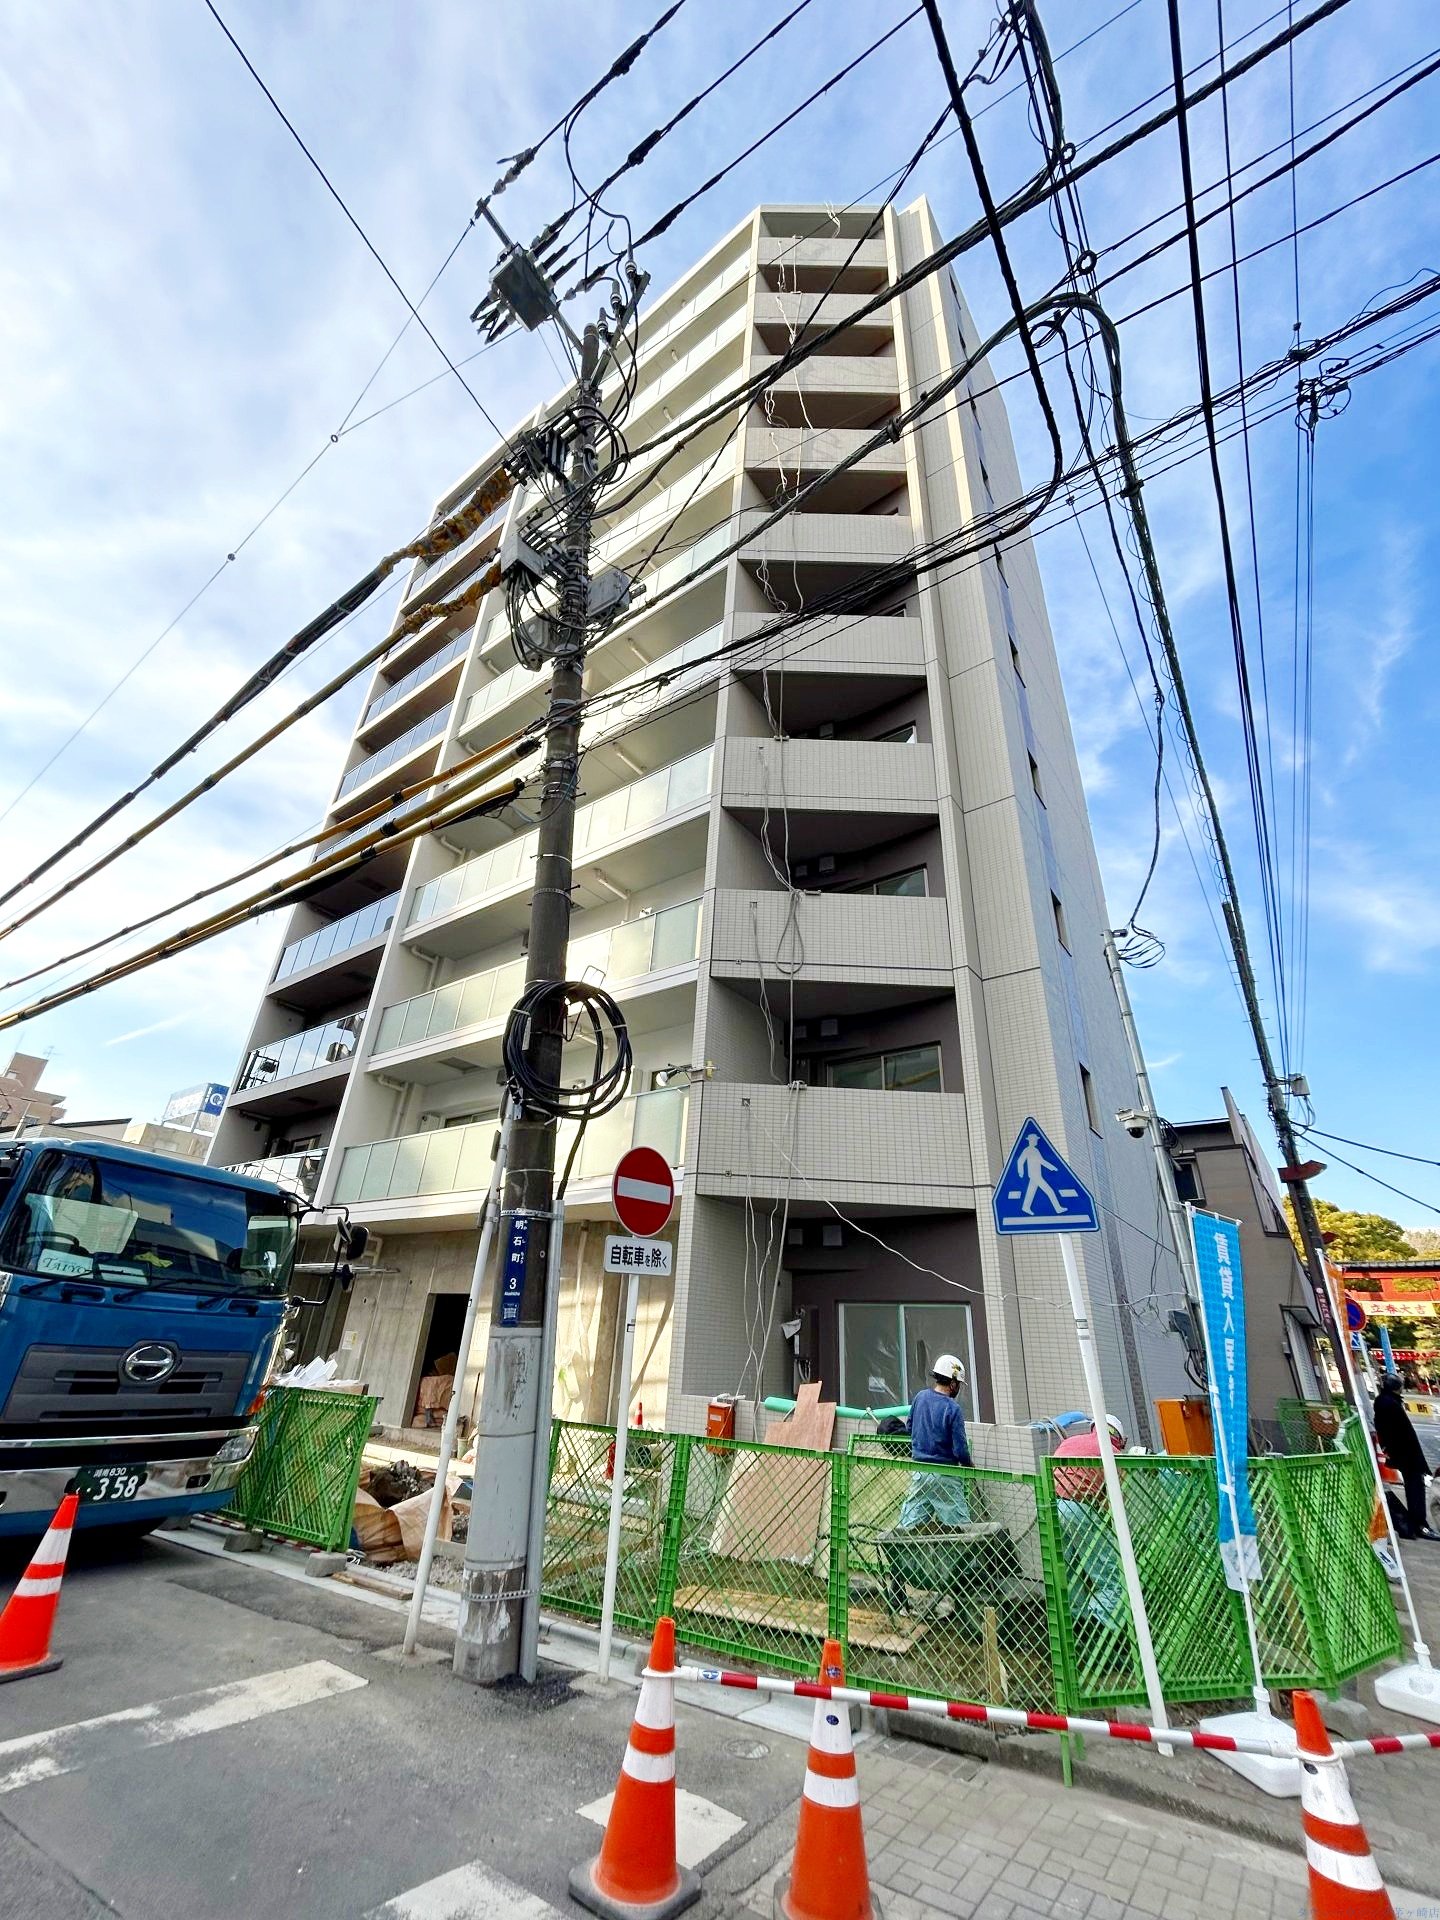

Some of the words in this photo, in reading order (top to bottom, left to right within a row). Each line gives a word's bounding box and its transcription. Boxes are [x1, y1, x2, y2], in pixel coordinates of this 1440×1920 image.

[512, 1220, 524, 1263] 明石町
[43, 1258, 87, 1273] TAIYO
[611, 1245, 667, 1268] 自転車を除く
[509, 1278, 517, 1289] 3
